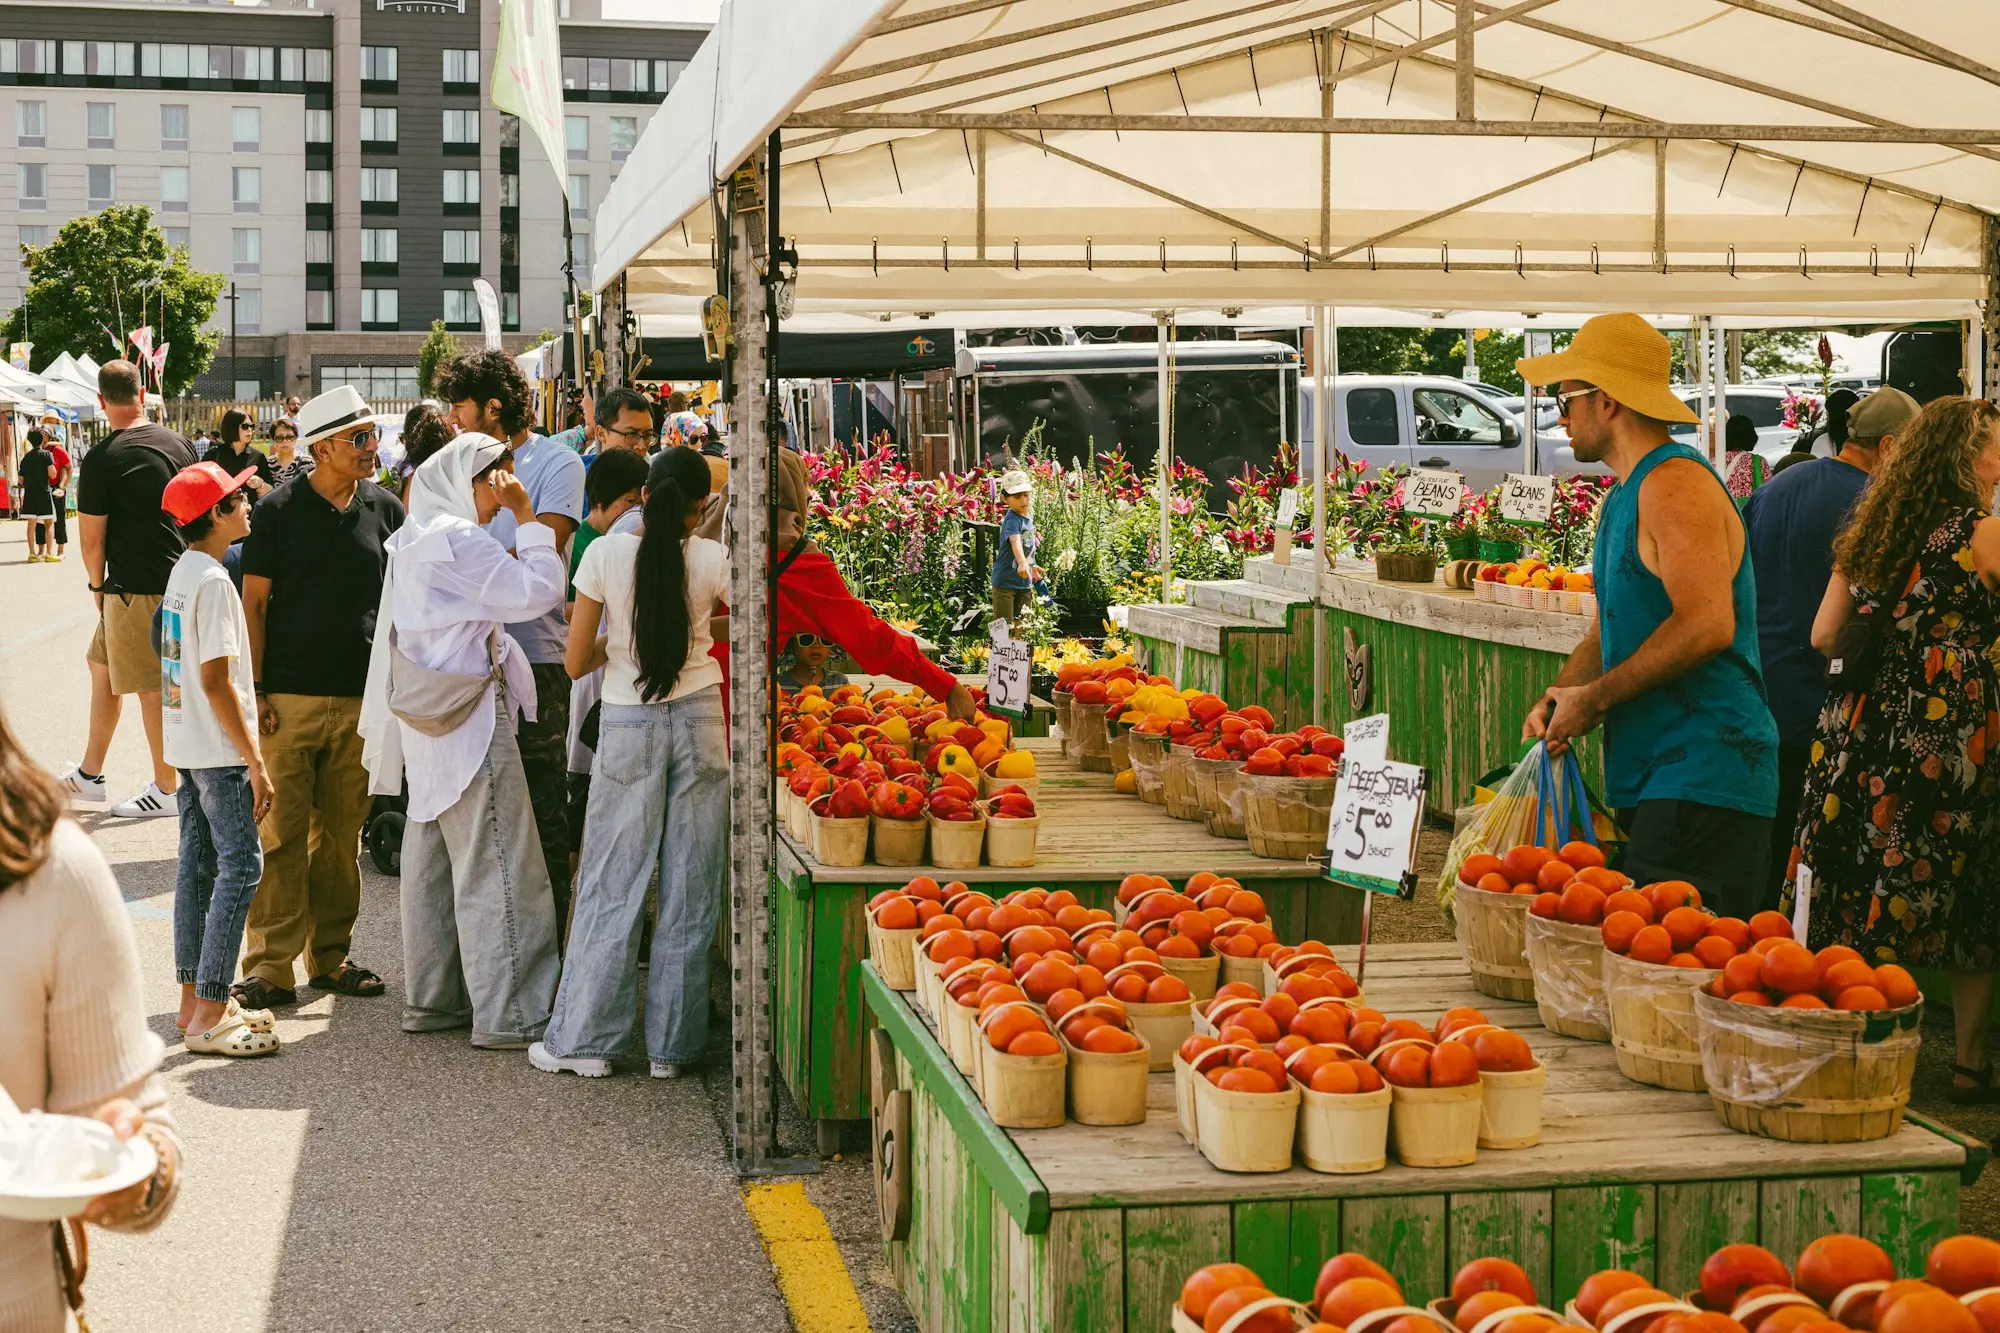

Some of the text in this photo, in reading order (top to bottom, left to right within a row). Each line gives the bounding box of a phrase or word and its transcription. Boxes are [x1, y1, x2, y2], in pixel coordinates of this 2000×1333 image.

[397, 5, 446, 13] SUITES
[906, 336, 935, 355] OTC
[1413, 482, 1456, 500] BEANS
[1511, 480, 1545, 501] BEANS
